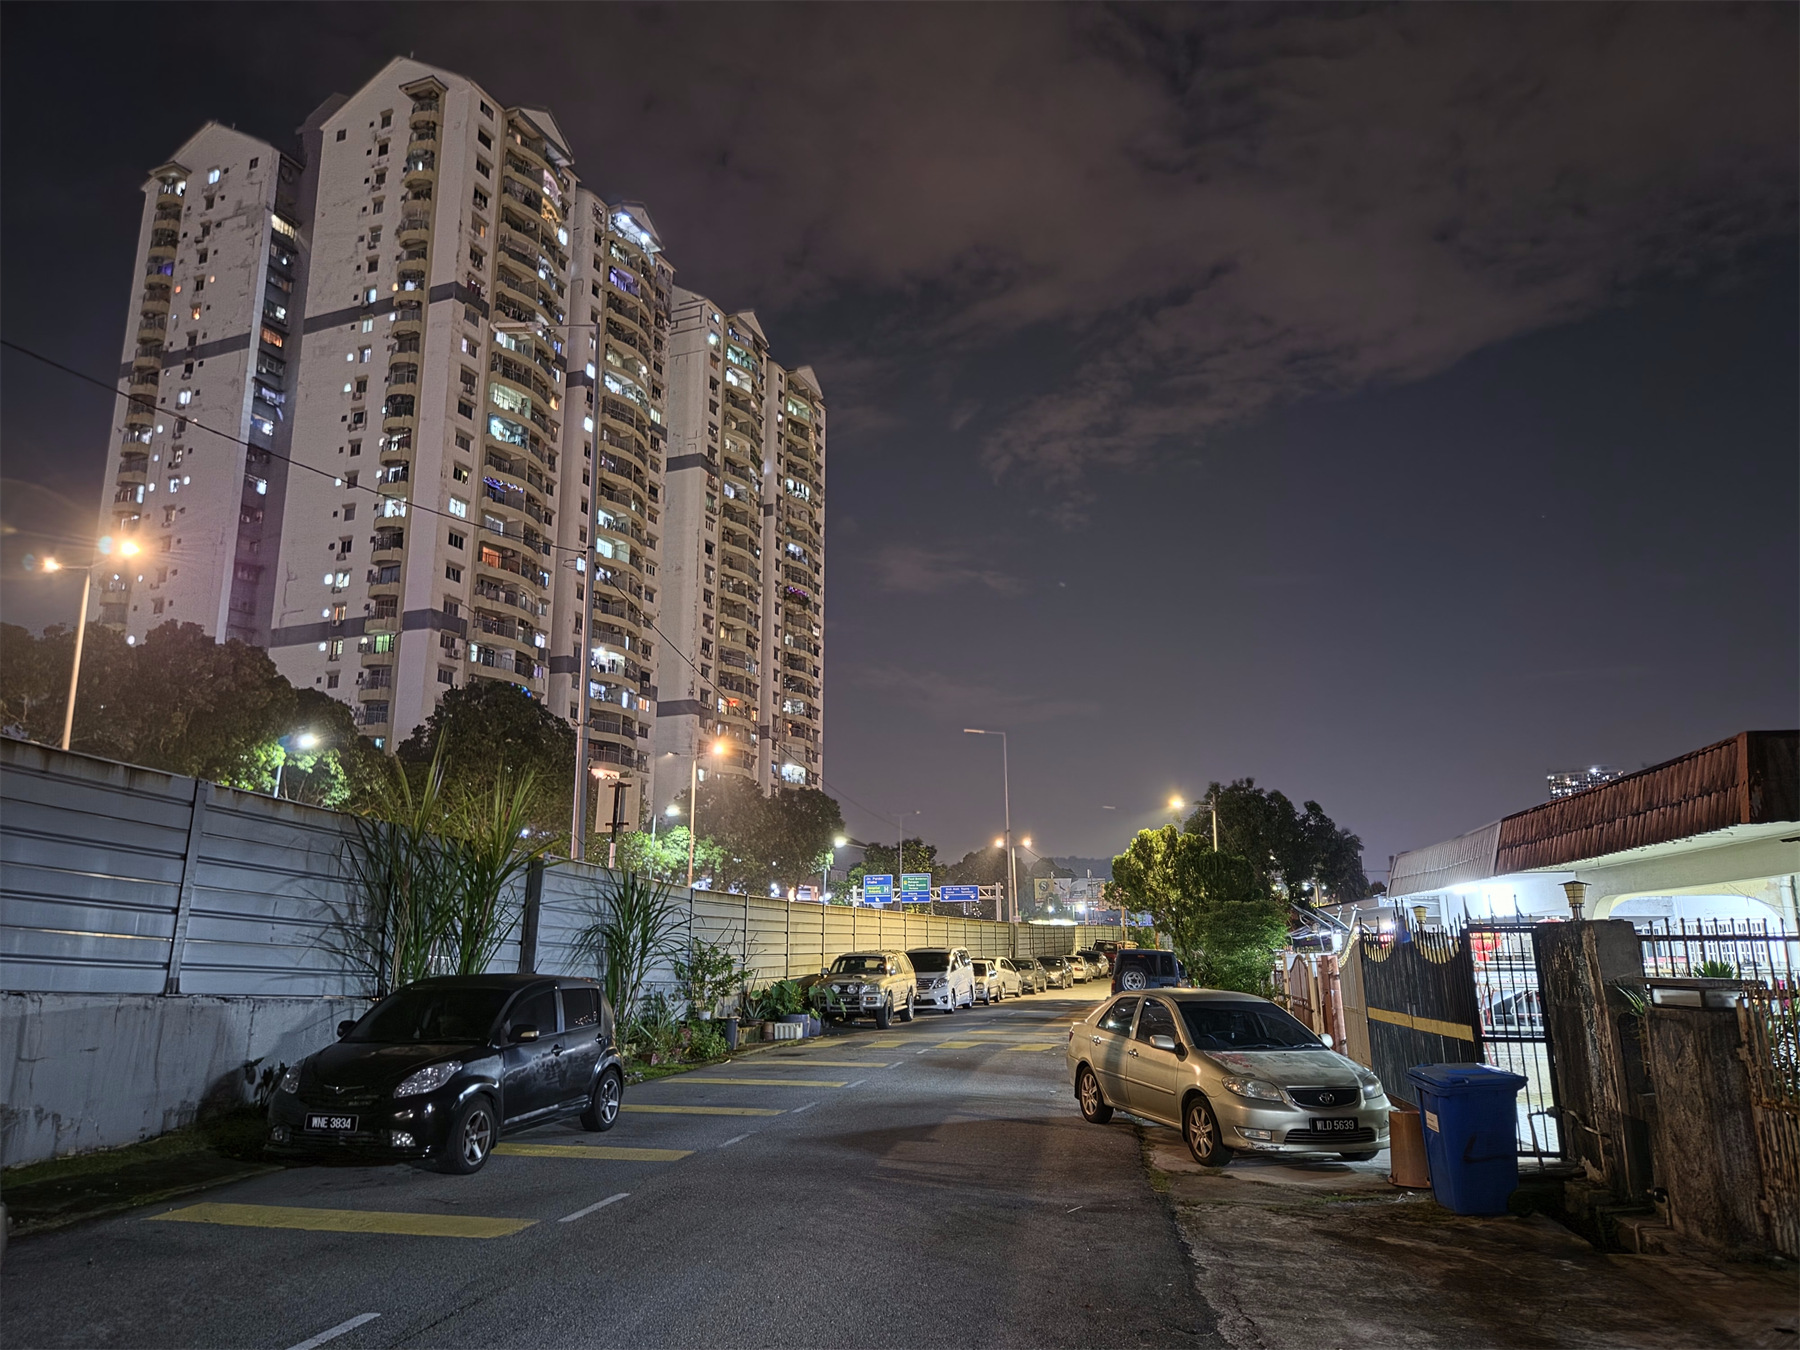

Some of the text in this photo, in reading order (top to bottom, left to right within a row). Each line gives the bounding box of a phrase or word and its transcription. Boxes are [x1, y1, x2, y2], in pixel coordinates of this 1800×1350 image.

[312, 1116, 351, 1129] WNE 3834
[1316, 1120, 1354, 1130] WLD 5639
